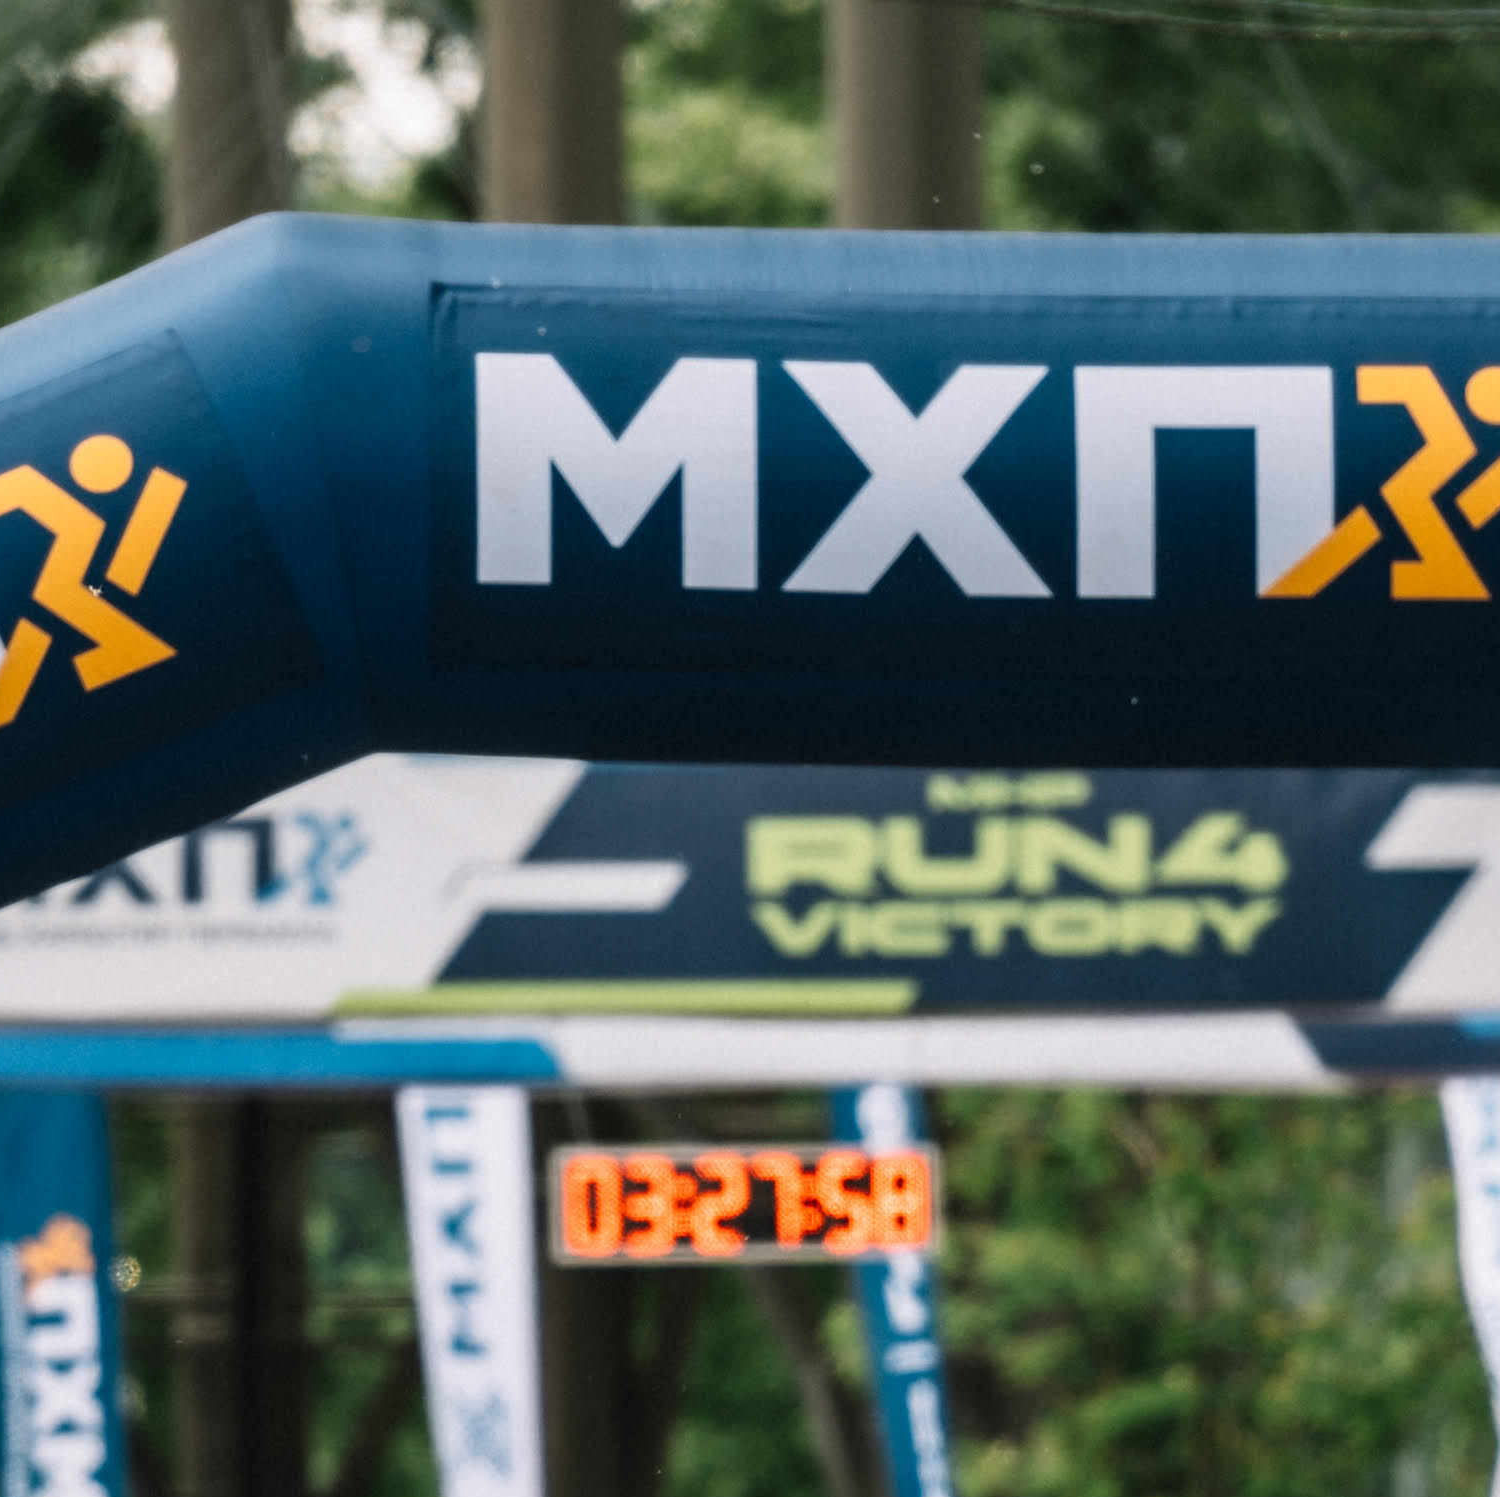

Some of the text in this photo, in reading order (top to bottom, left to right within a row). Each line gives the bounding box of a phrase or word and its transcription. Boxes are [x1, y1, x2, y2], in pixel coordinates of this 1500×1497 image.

[475, 352, 1335, 598] МХП
[24, 819, 276, 906] ХП
[748, 897, 1284, 958] VICTORY
